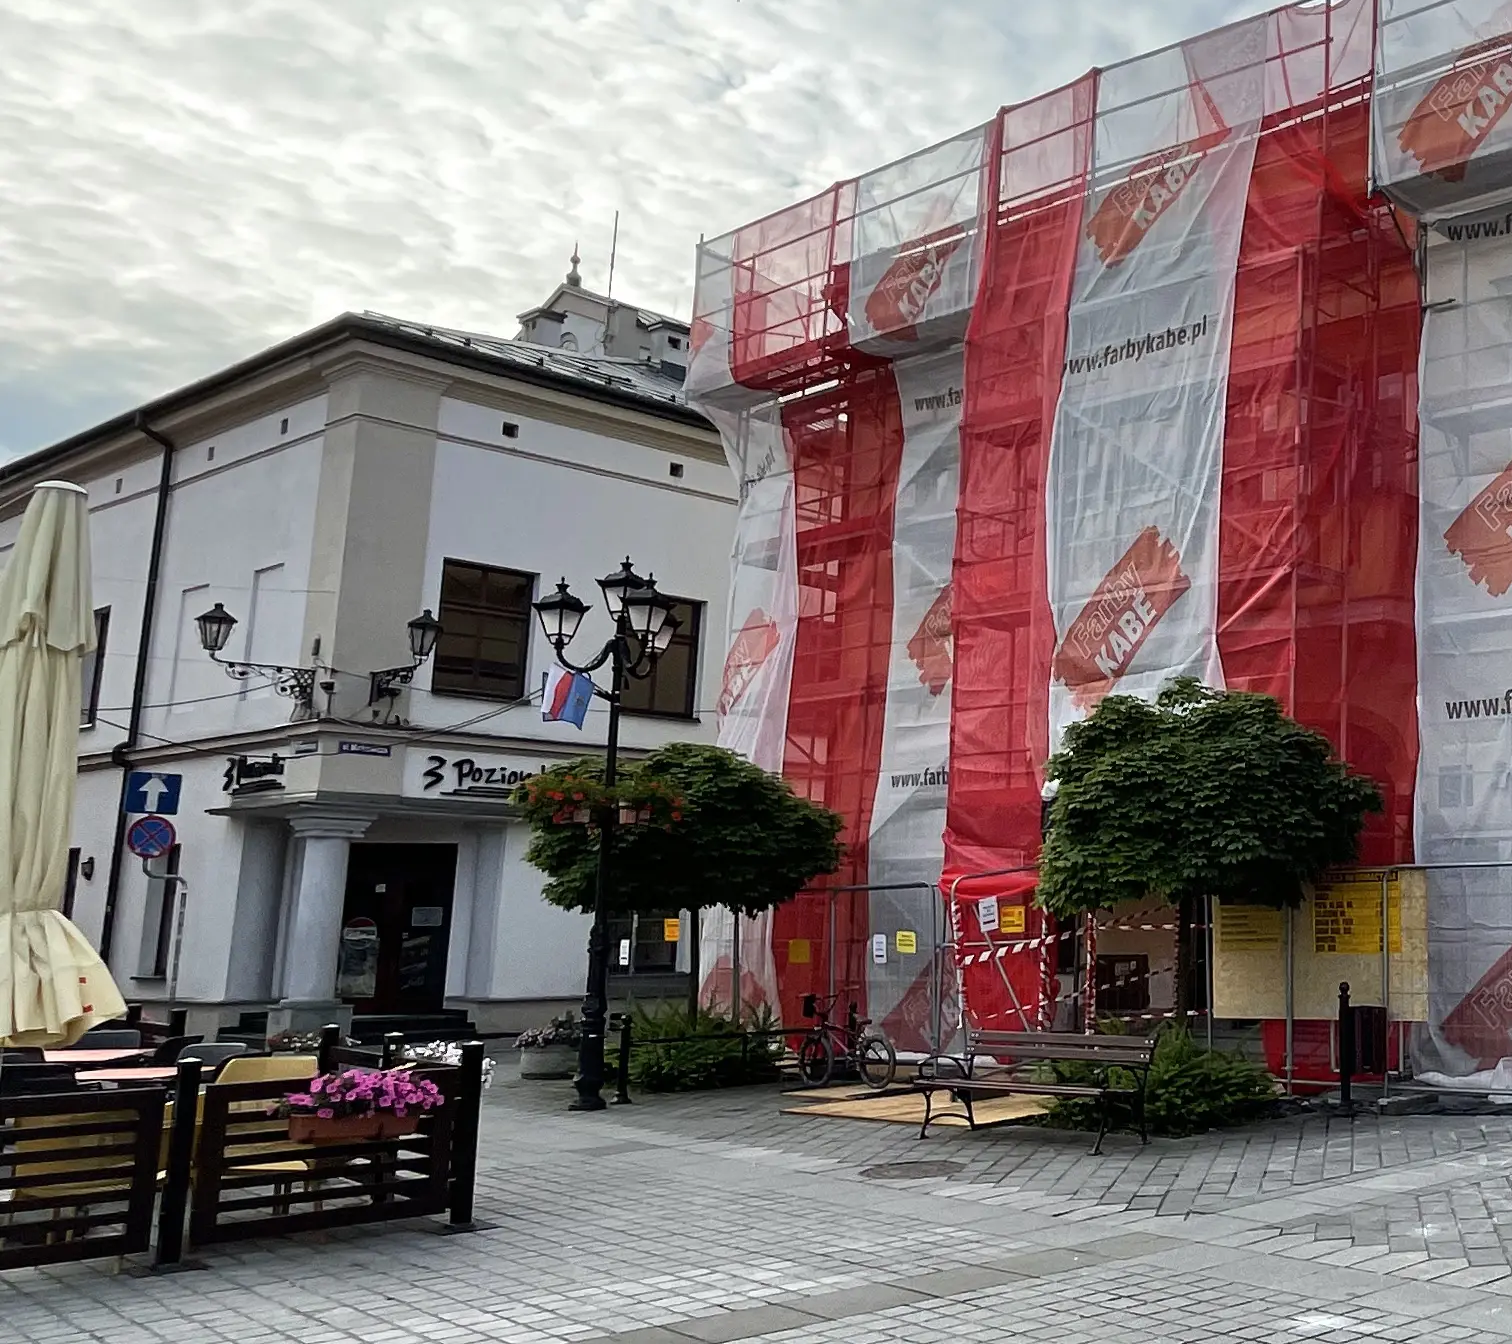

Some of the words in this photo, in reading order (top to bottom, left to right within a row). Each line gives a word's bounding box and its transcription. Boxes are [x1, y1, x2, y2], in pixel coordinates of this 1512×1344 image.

[1064, 314, 1207, 374] ww.farbykabe.pl
[1072, 561, 1143, 659] Farby
[1094, 588, 1157, 678] KABE
[423, 756, 447, 791] 3
